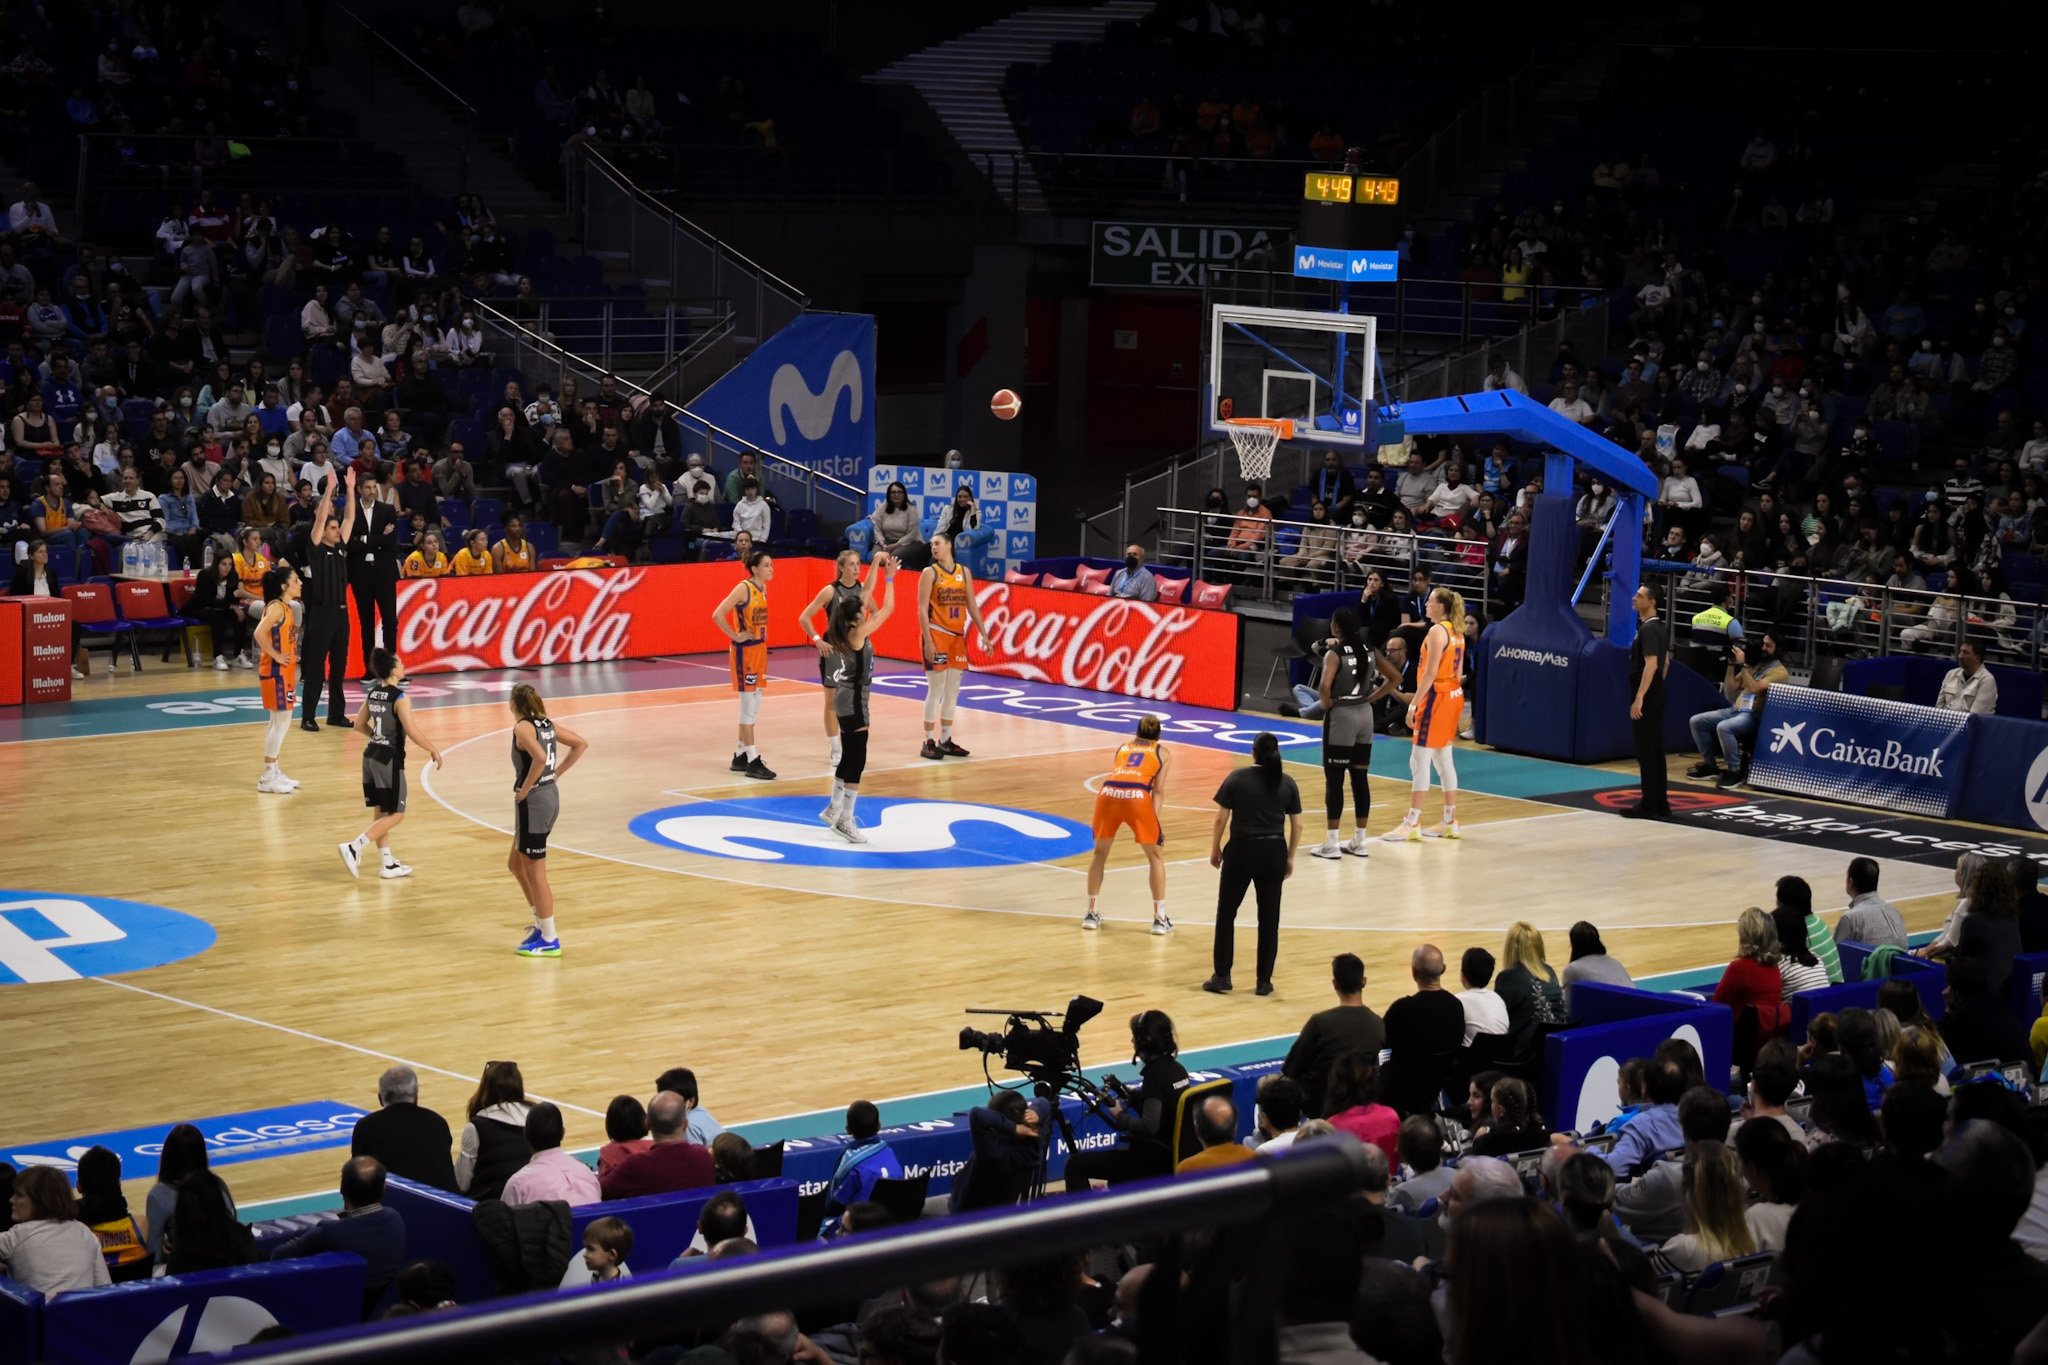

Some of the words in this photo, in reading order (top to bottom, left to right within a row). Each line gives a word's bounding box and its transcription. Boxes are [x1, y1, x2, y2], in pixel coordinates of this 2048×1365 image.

[1316, 178, 1352, 200] 4:49
[1365, 180, 1398, 202] 4:49
[1102, 226, 1277, 261] SALIDA
[1317, 258, 1344, 269] Movistar
[1369, 262, 1394, 271] Movistar
[1151, 261, 1228, 286] EXIT
[33, 612, 65, 624] Mahou
[949, 606, 960, 619] 14
[33, 645, 65, 656] Mahou
[32, 677, 64, 689] Mahou
[545, 742, 555, 770] 4
[1126, 752, 1145, 767] 9
[1809, 727, 1944, 778] CaixaBank
[1101, 787, 1145, 799] PAMESA
